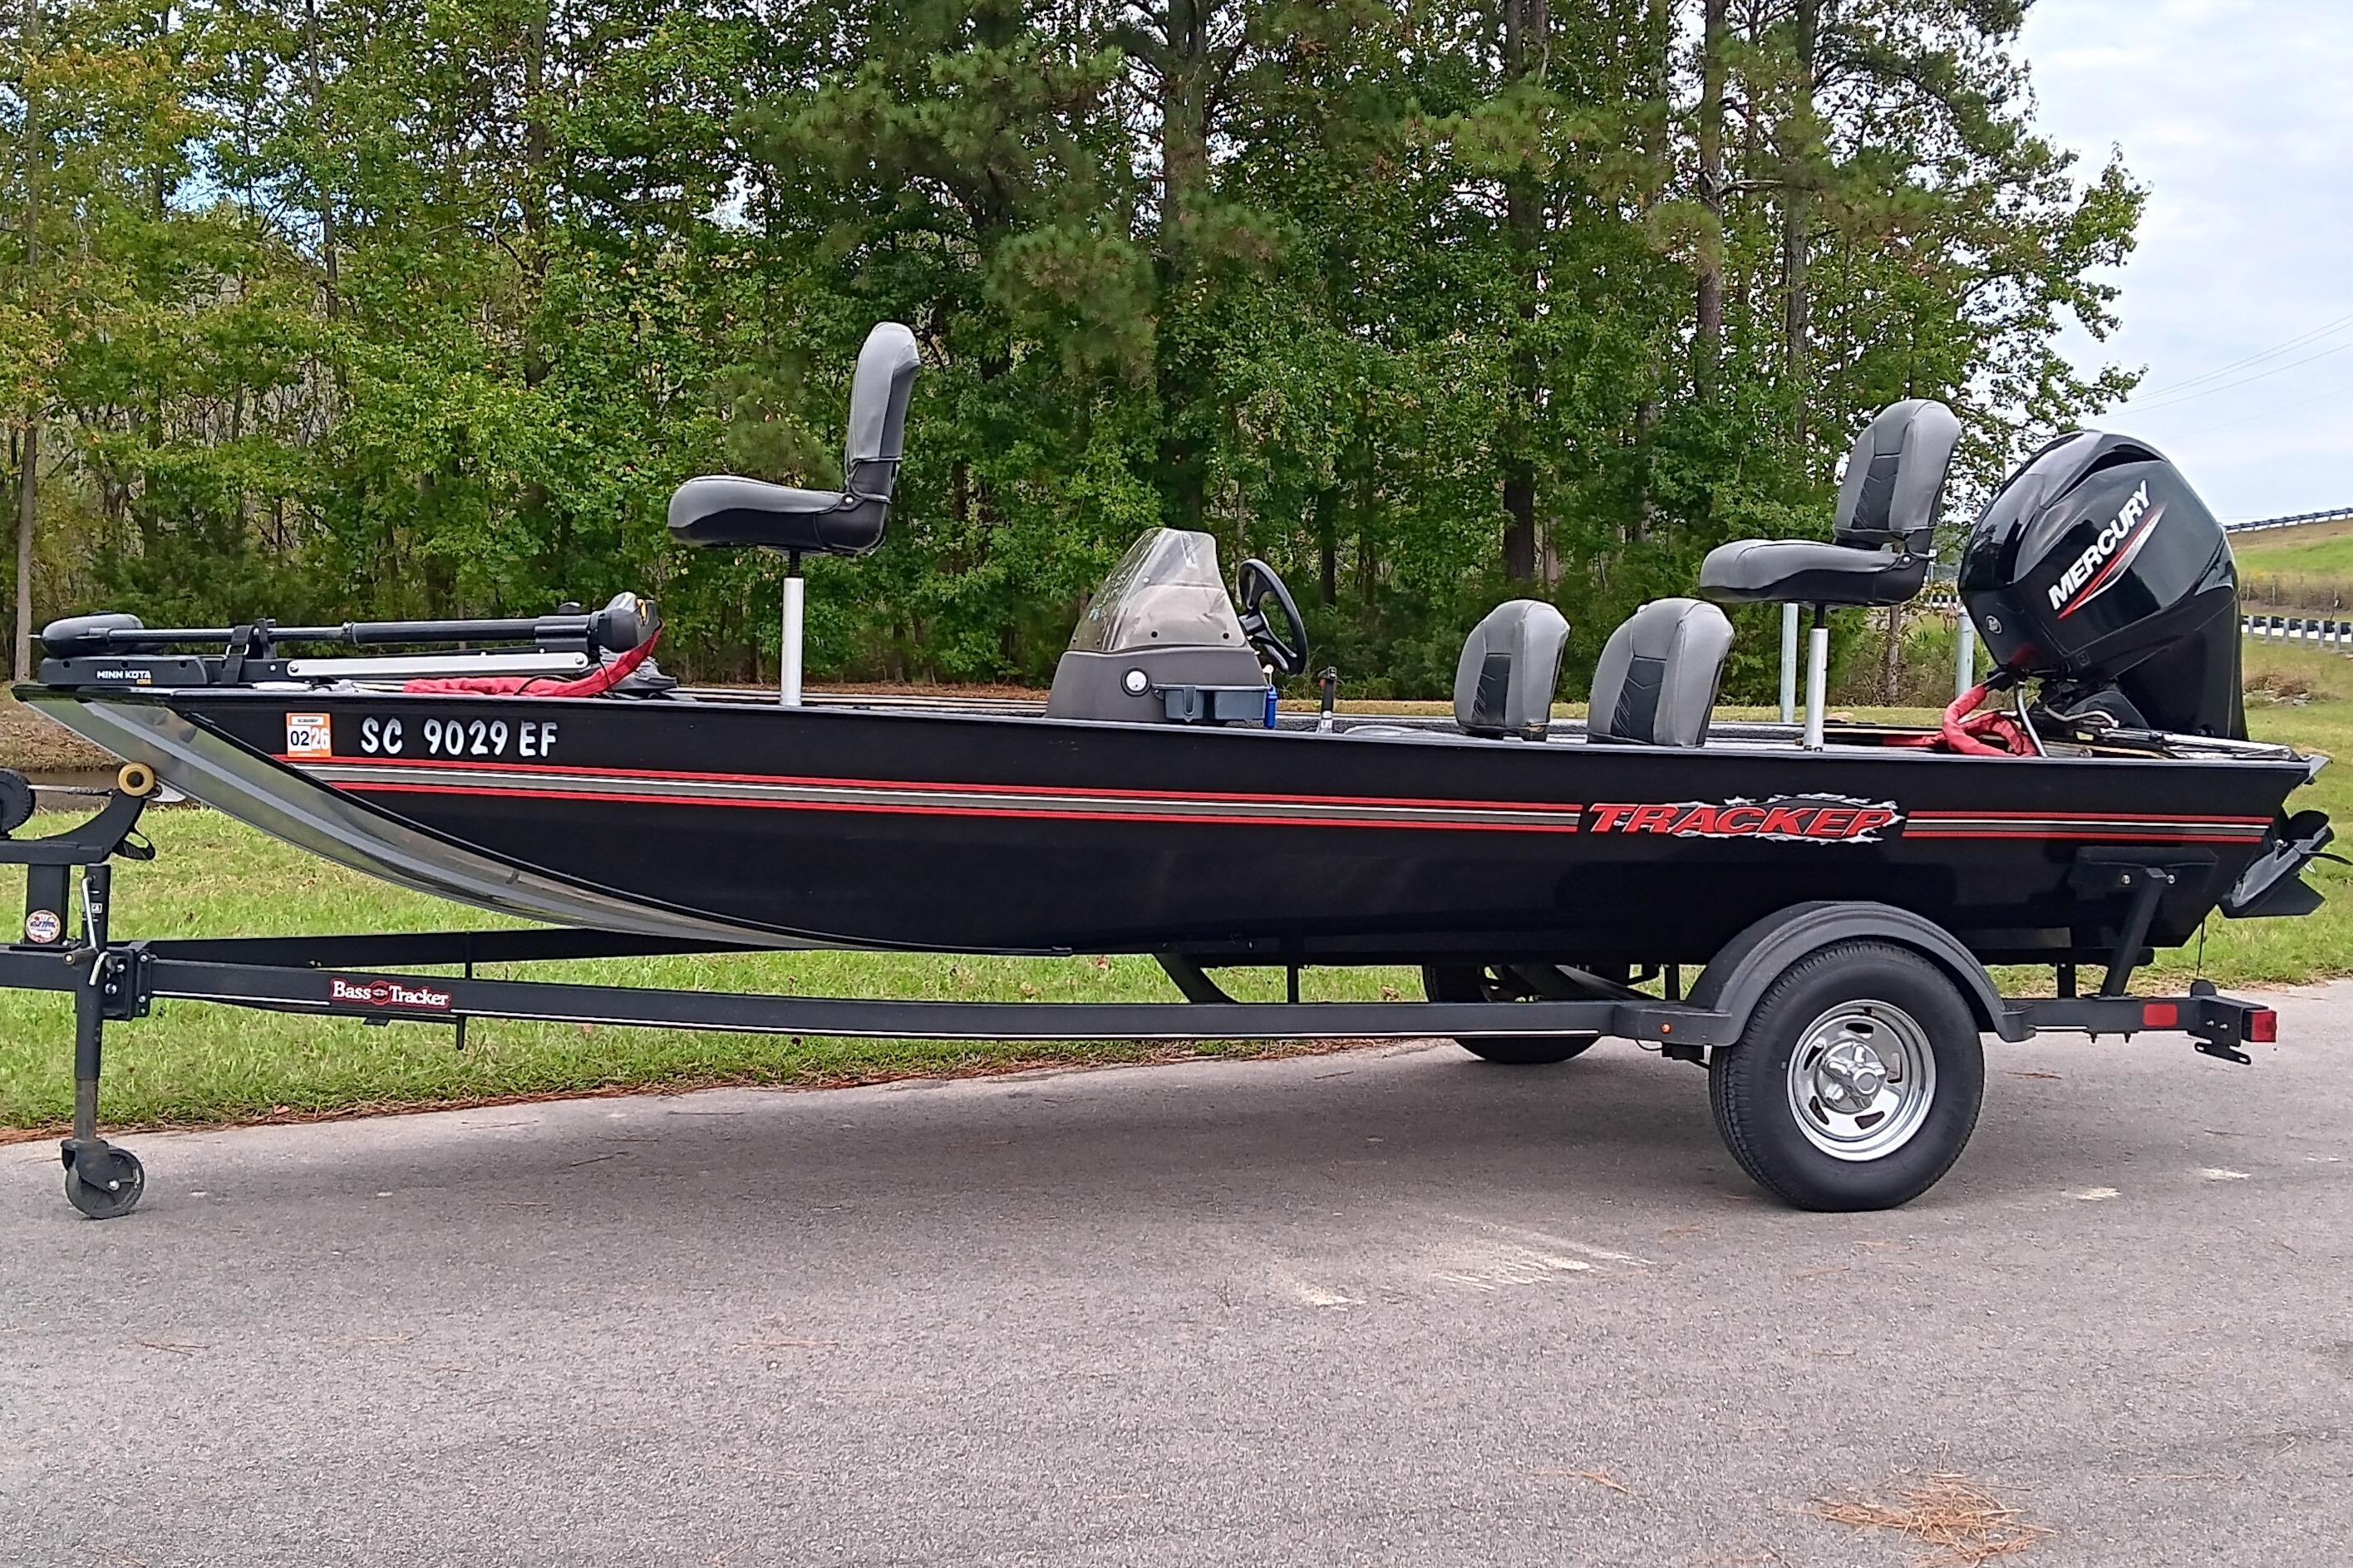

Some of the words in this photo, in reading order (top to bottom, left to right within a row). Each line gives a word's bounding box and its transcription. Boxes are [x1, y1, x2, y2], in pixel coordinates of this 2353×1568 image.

[2048, 479, 2150, 611] MERCURY
[96, 670, 124, 680] MINN
[125, 670, 151, 680] KOTA
[291, 730, 310, 746] 02
[311, 726, 331, 750] 26
[361, 717, 402, 755] SC
[423, 719, 508, 755] 9029
[519, 720, 558, 757] EF
[1588, 804, 1893, 838] TRACKER
[332, 981, 372, 1000] Bass
[388, 985, 449, 1006] Tracker
